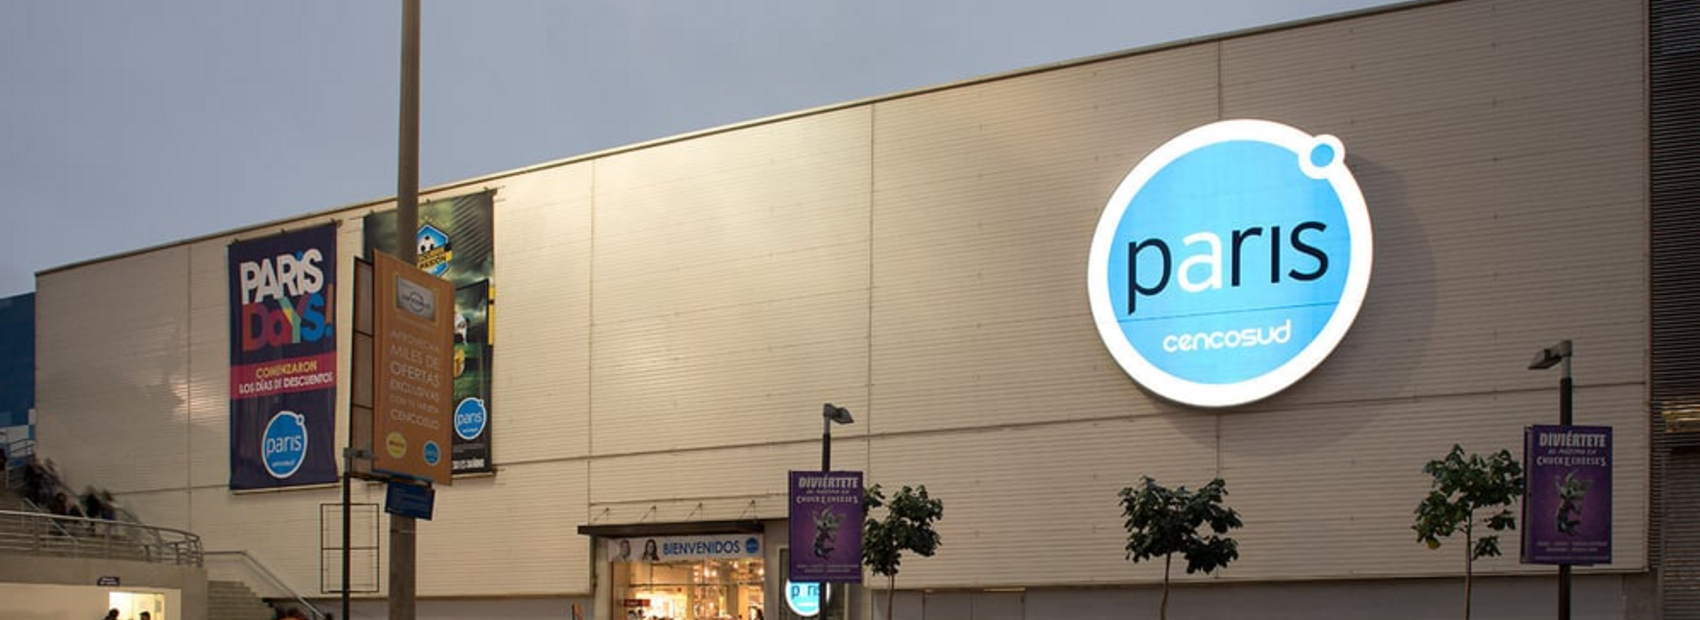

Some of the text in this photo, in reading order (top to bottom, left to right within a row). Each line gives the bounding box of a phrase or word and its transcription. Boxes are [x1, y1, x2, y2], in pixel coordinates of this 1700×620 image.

[1128, 221, 1329, 316] paris
[1163, 319, 1292, 352] cencosud
[389, 343, 439, 370] MILES DE
[390, 360, 439, 388] OFERTAS
[266, 435, 302, 458] paris
[662, 540, 741, 556] BIENVENIDOS
